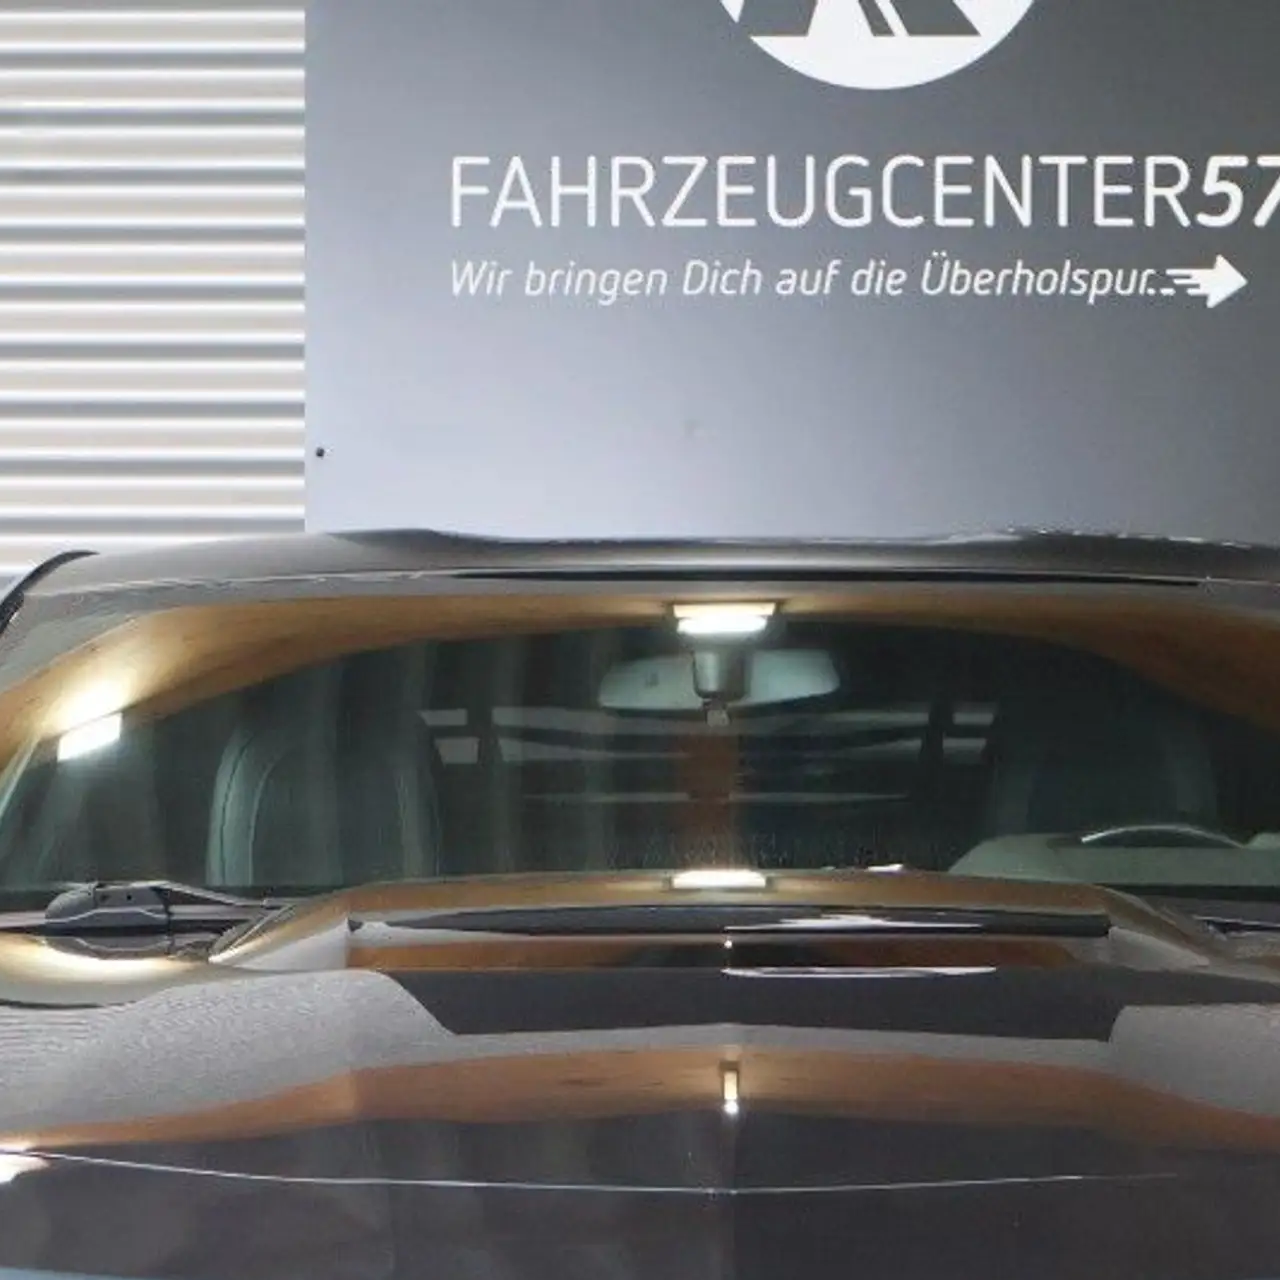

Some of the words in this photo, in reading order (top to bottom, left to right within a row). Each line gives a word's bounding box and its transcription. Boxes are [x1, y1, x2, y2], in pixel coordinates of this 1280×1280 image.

[450, 259, 513, 297] Wir
[523, 259, 669, 306] bringen
[682, 259, 763, 296] Dich
[775, 259, 842, 297] auf
[850, 259, 907, 297] die
